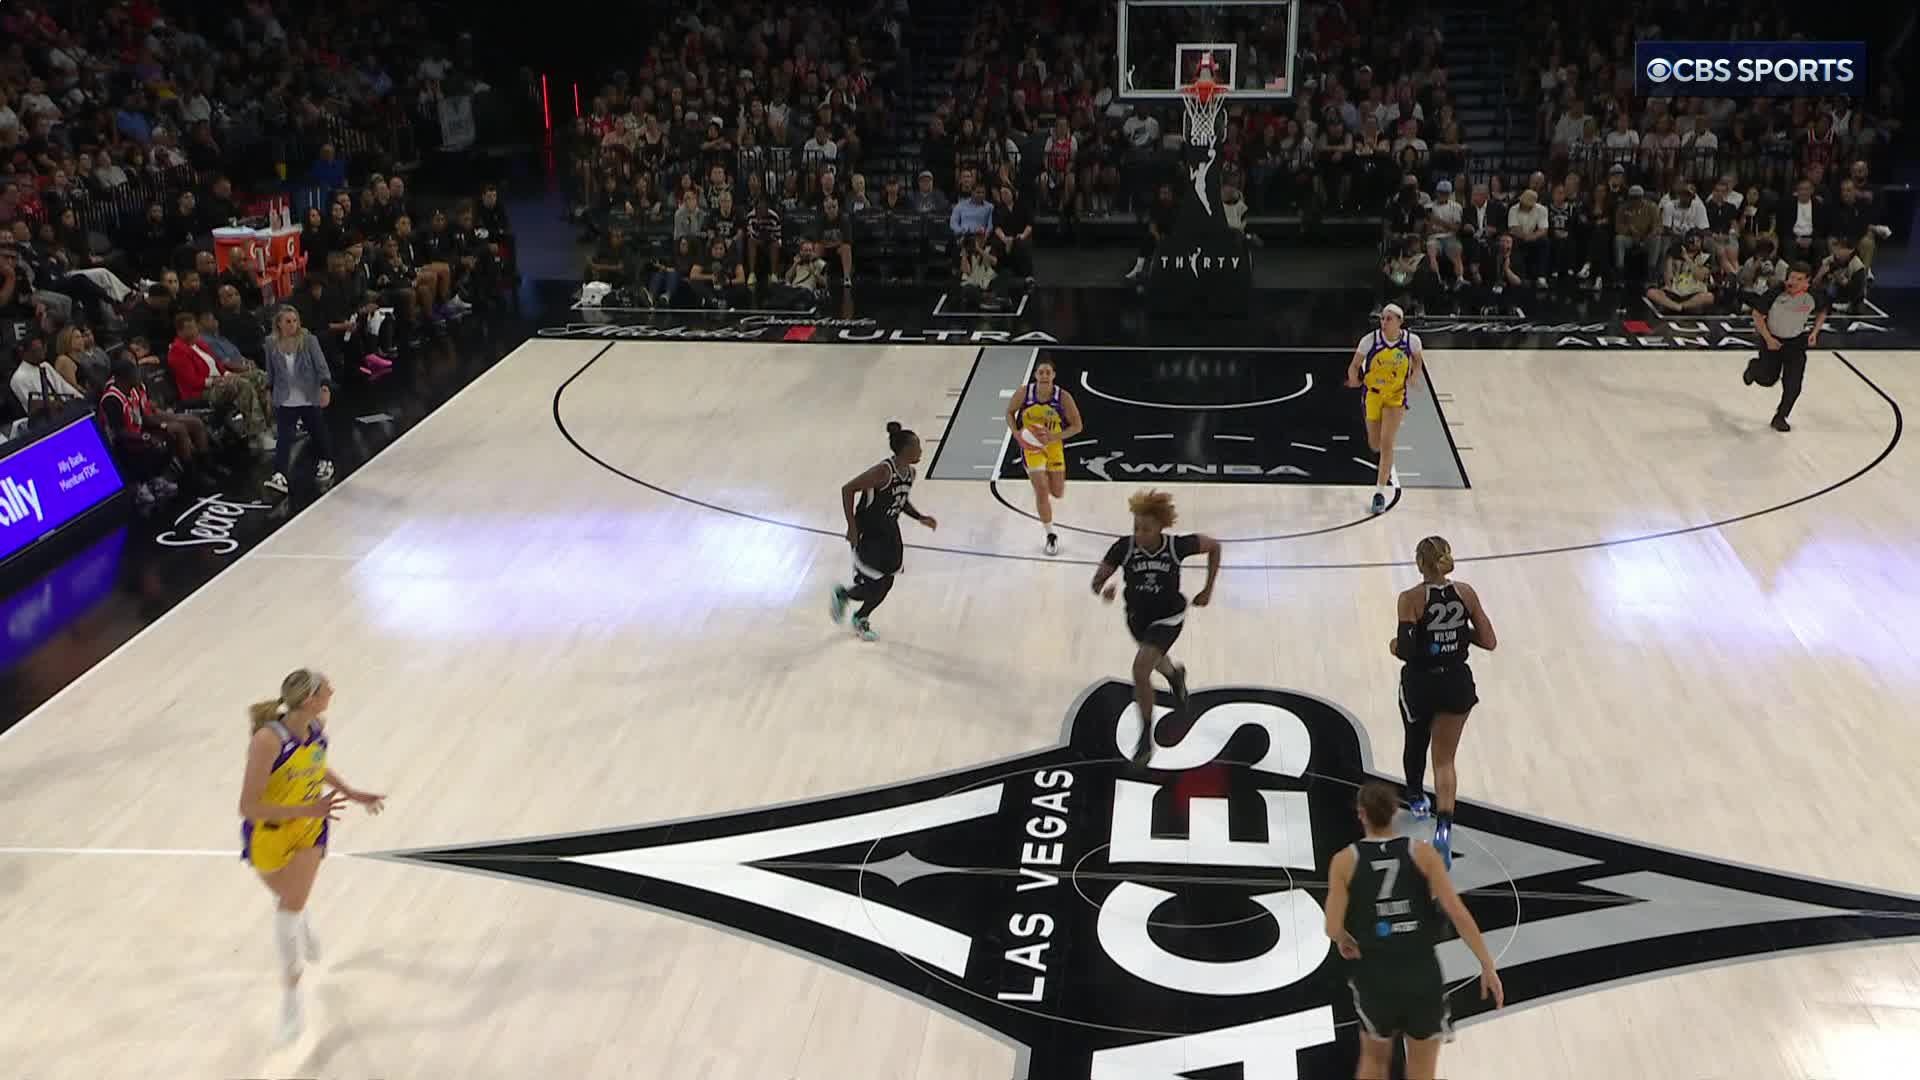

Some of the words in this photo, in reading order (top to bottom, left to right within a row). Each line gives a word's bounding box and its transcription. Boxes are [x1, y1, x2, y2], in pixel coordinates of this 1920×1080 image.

[838, 329, 1060, 343] ULTRA
[1556, 336, 1756, 346] ARENA
[1119, 462, 1311, 477] WNBA
[156, 493, 272, 554] Secret
[1427, 601, 1465, 631] 22
[1434, 630, 1457, 642] WILSON
[1016, 769, 1074, 892] VEGAS
[1370, 858, 1400, 900] 7
[997, 912, 1055, 1002] LAS
